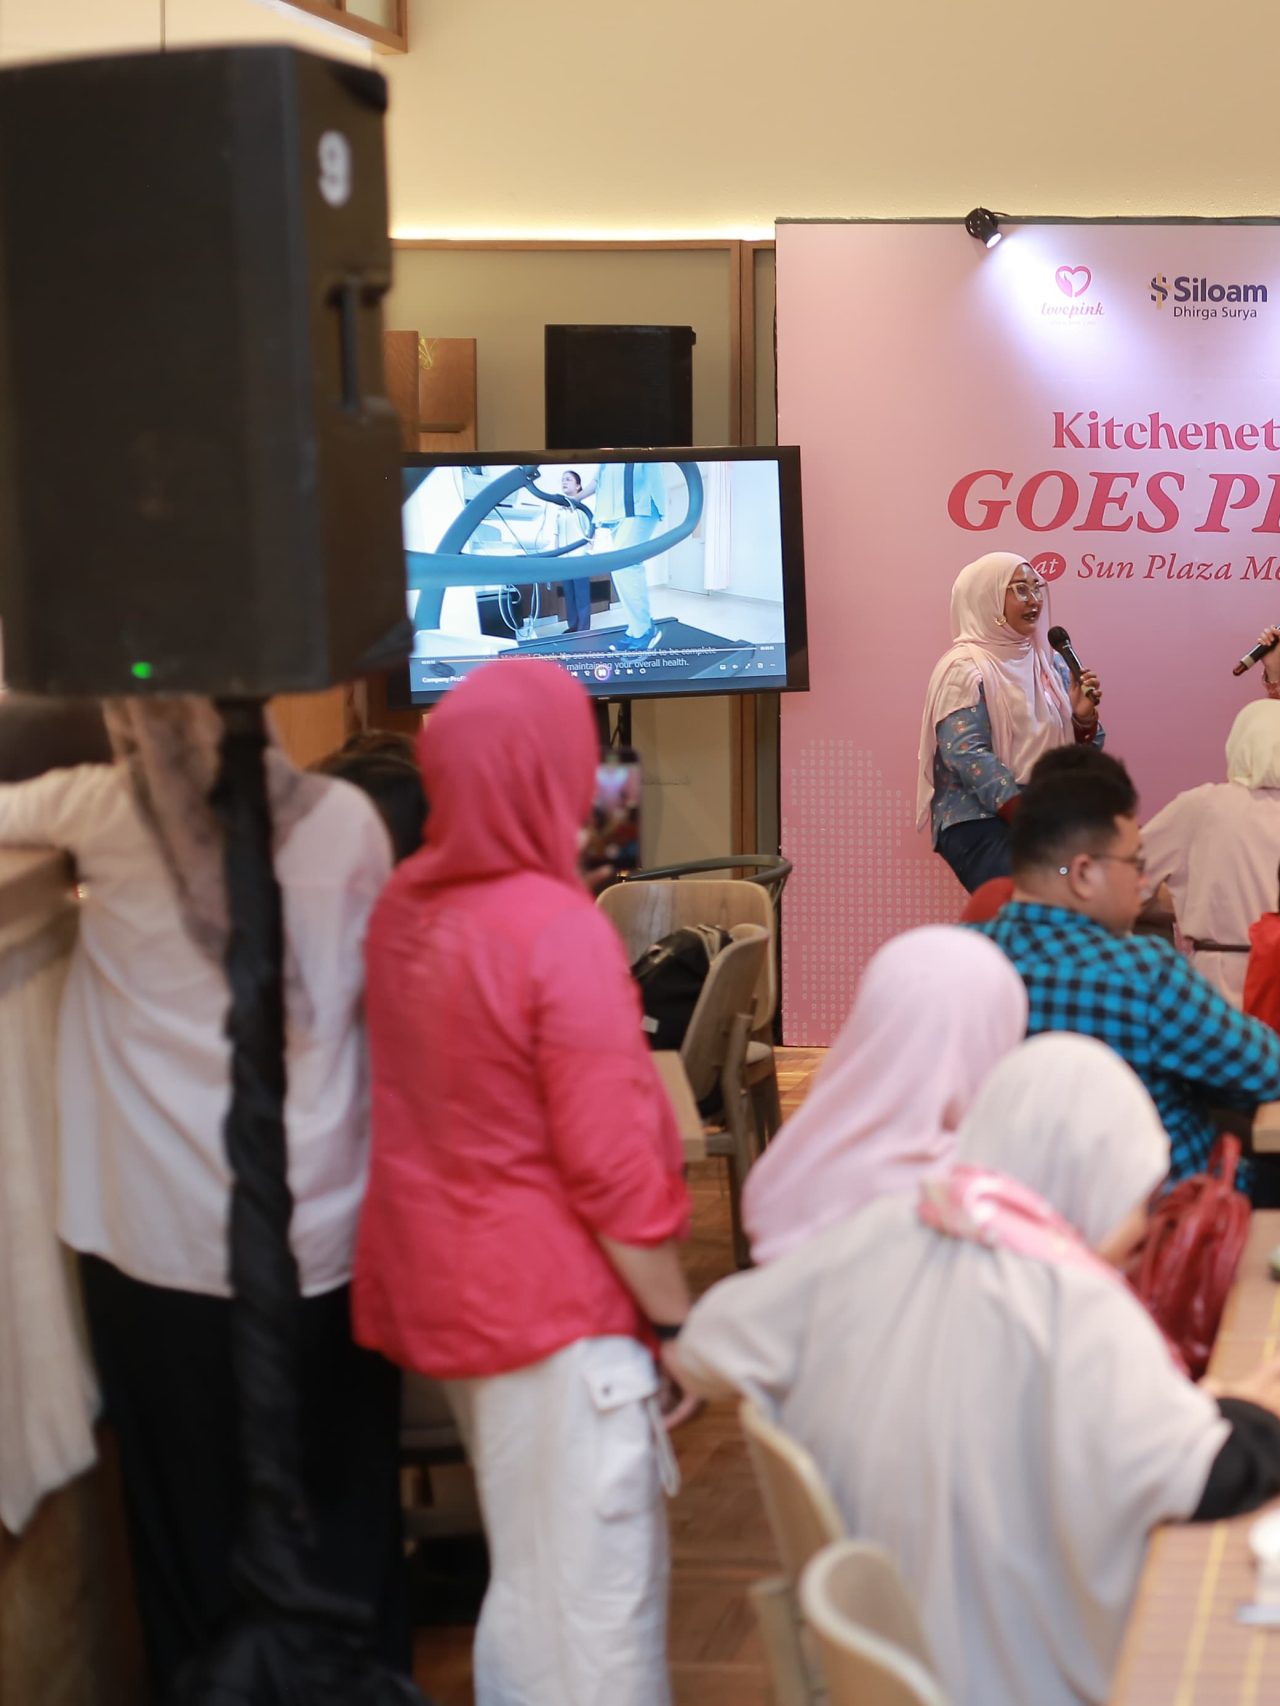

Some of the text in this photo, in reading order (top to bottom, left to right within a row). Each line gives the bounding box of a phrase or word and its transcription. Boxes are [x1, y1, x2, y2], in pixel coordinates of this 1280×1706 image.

[318, 130, 352, 207] 9
[1174, 276, 1268, 302] Siloam
[1041, 301, 1105, 319] lovepink
[1173, 306, 1257, 320] Dhirga Surya
[947, 469, 1186, 533] GOES
[1035, 558, 1059, 575] at
[1077, 552, 1135, 579] Sun
[1143, 552, 1233, 580] Plaza
[614, 661, 632, 671] your
[634, 658, 661, 668] overall
[662, 657, 689, 667] health.
